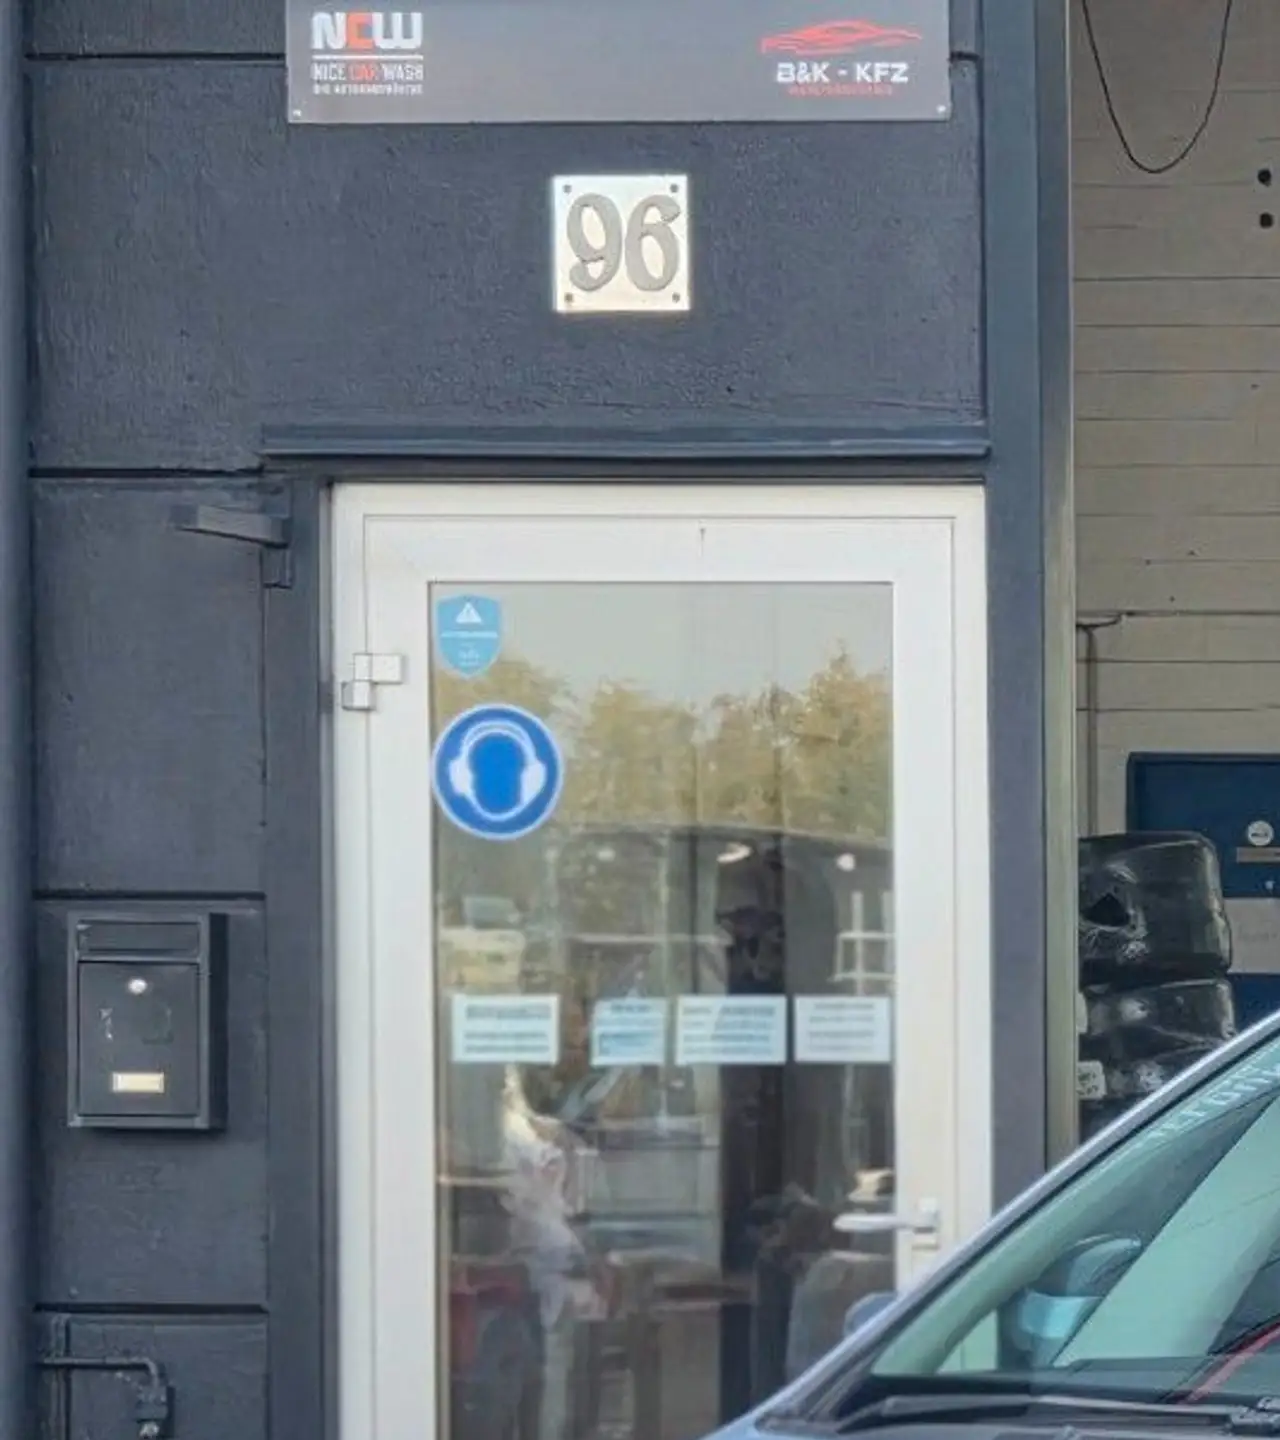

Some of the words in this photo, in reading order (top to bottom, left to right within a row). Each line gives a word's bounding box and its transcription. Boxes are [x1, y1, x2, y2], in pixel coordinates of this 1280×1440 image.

[311, 12, 423, 49] NCW
[776, 62, 830, 83] B&K
[855, 62, 909, 83] KFZ
[566, 193, 681, 292] 96
